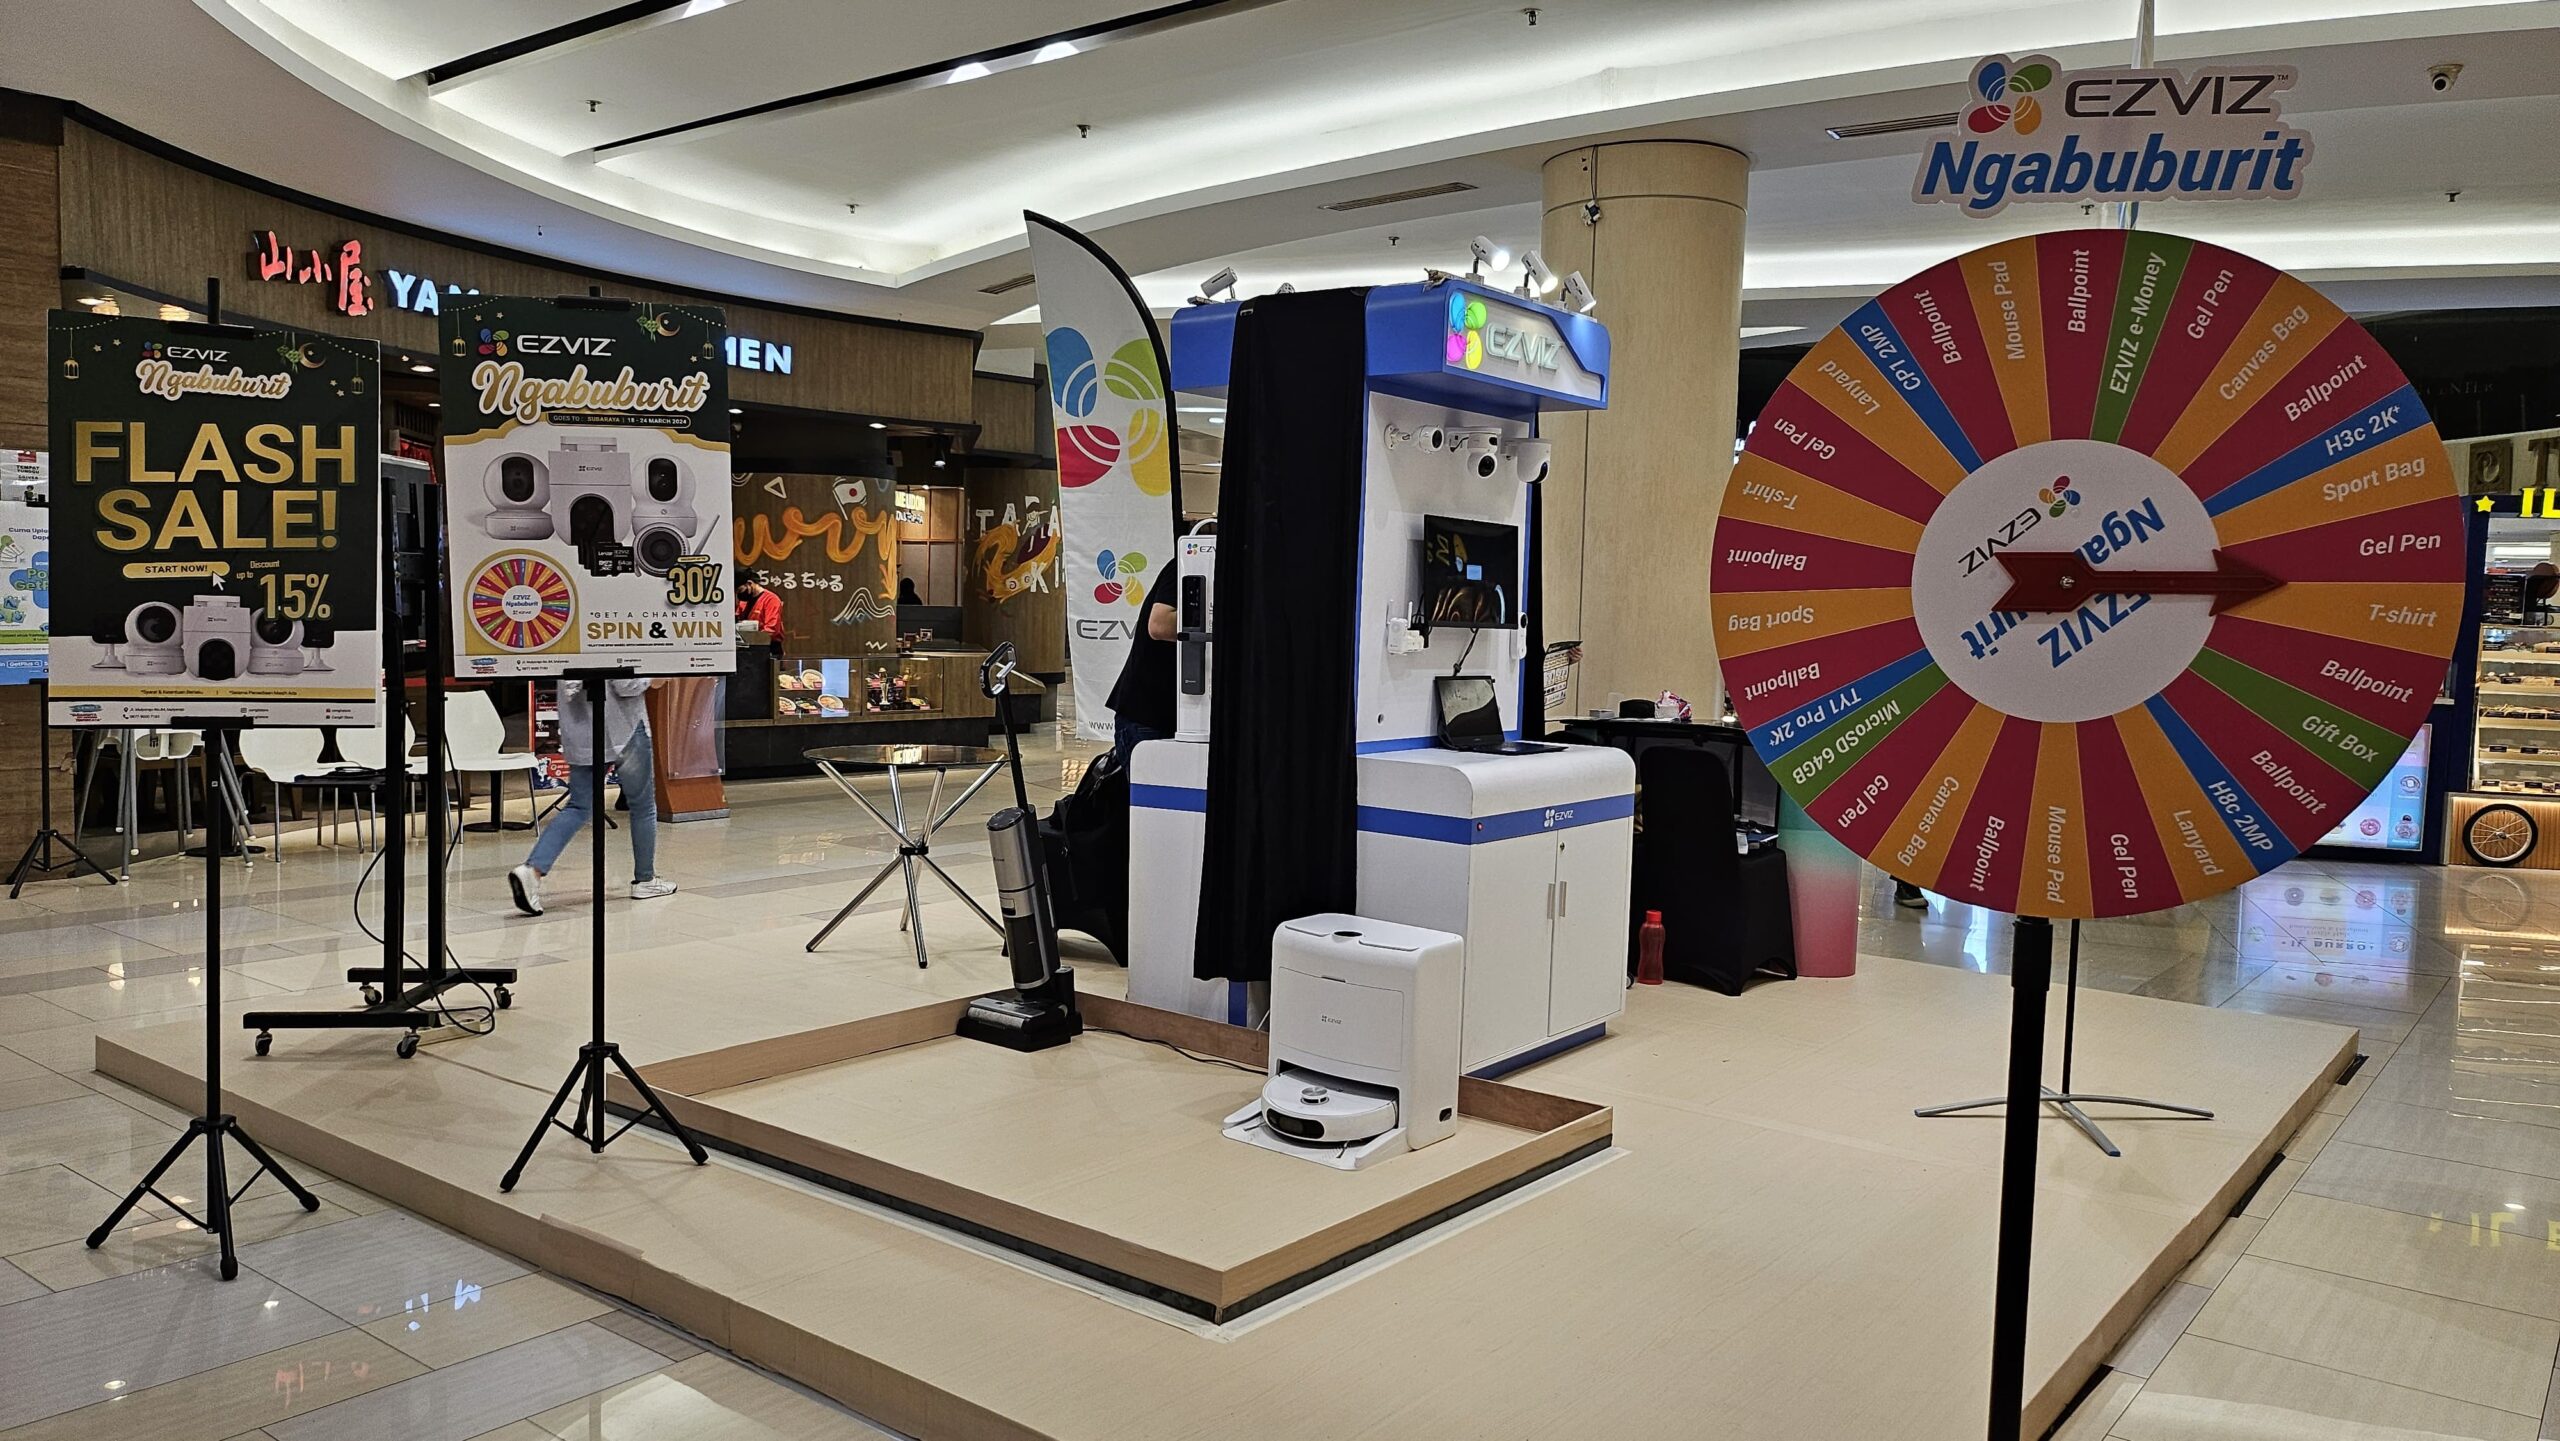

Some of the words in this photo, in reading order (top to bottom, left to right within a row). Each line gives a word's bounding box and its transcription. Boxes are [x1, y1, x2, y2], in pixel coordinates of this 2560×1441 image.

[1921, 131, 2304, 210] Ngabuburit
[260, 230, 374, 316] 山小屋
[1987, 261, 2012, 296] Pad
[2068, 249, 2093, 333] Ballpoint
[388, 269, 480, 316] YA
[2187, 305, 2214, 340] Gel
[2203, 268, 2234, 307] Pen
[1861, 324, 1897, 358] 2MP
[1914, 289, 1962, 364] Ballpoint
[2001, 300, 2026, 360] Mouse
[2109, 337, 2140, 395] EZVIZ
[2130, 251, 2167, 335] e-Money
[167, 346, 230, 362] EZVIZ
[516, 334, 612, 356] EZVIZ
[1487, 322, 1564, 373] EZVIZ
[2219, 339, 2277, 401] Canvas
[2271, 304, 2310, 341] Bag
[138, 361, 291, 399] Ngabuburit
[474, 362, 709, 424] Ngabuburit
[1817, 360, 1881, 415] Lanyard
[1889, 359, 1921, 391] CP1
[2284, 354, 2368, 422] Ballpoint
[1774, 418, 1808, 446] Pen
[1804, 436, 1836, 460] Gel
[2325, 427, 2366, 456] H3c
[74, 421, 357, 484] FLASH
[1742, 480, 1799, 510] T-shirt
[2322, 470, 2380, 502] Sport
[2385, 457, 2425, 482] Bag
[96, 489, 338, 550] SALE!
[1727, 549, 1807, 571] Ballpoint
[2359, 535, 2394, 557] Gel
[2400, 533, 2441, 552] Pen
[145, 565, 177, 573] START
[236, 572, 245, 580] up
[250, 560, 280, 569] Discount
[259, 573, 331, 618] 15%
[668, 564, 723, 605] 30%
[587, 621, 643, 640] SPIN
[649, 621, 667, 638] &
[674, 621, 722, 639] WIN
[1728, 614, 1762, 631] Bag
[1765, 605, 1815, 624] Sport
[2368, 603, 2438, 628] T-shirt
[1744, 662, 1821, 701] Ballpoint
[2320, 659, 2414, 703] Ballpoint
[1796, 706, 1826, 729] Pro
[1829, 687, 1862, 714] TY1
[1835, 700, 1901, 754] MicroSD
[2301, 715, 2341, 744] Gift
[2338, 733, 2379, 763] Box
[1792, 747, 1836, 785] 64GB
[2250, 750, 2328, 815] Ballpoint
[1863, 775, 1889, 804] Gel
[1918, 776, 1960, 834] Canvas
[1555, 809, 1574, 821] EZVIZ
[1837, 798, 1869, 829] Pen
[2208, 780, 2241, 815] H8c
[2233, 814, 2274, 853] 2MP
[1896, 833, 1928, 867] Bag
[1969, 815, 2006, 892] Ballpoint
[2047, 806, 2067, 864] Mouse
[2110, 833, 2136, 861] Gel
[2173, 810, 2225, 876] Lanyard
[2047, 869, 2066, 904] Pad
[2117, 865, 2139, 899] Pen
